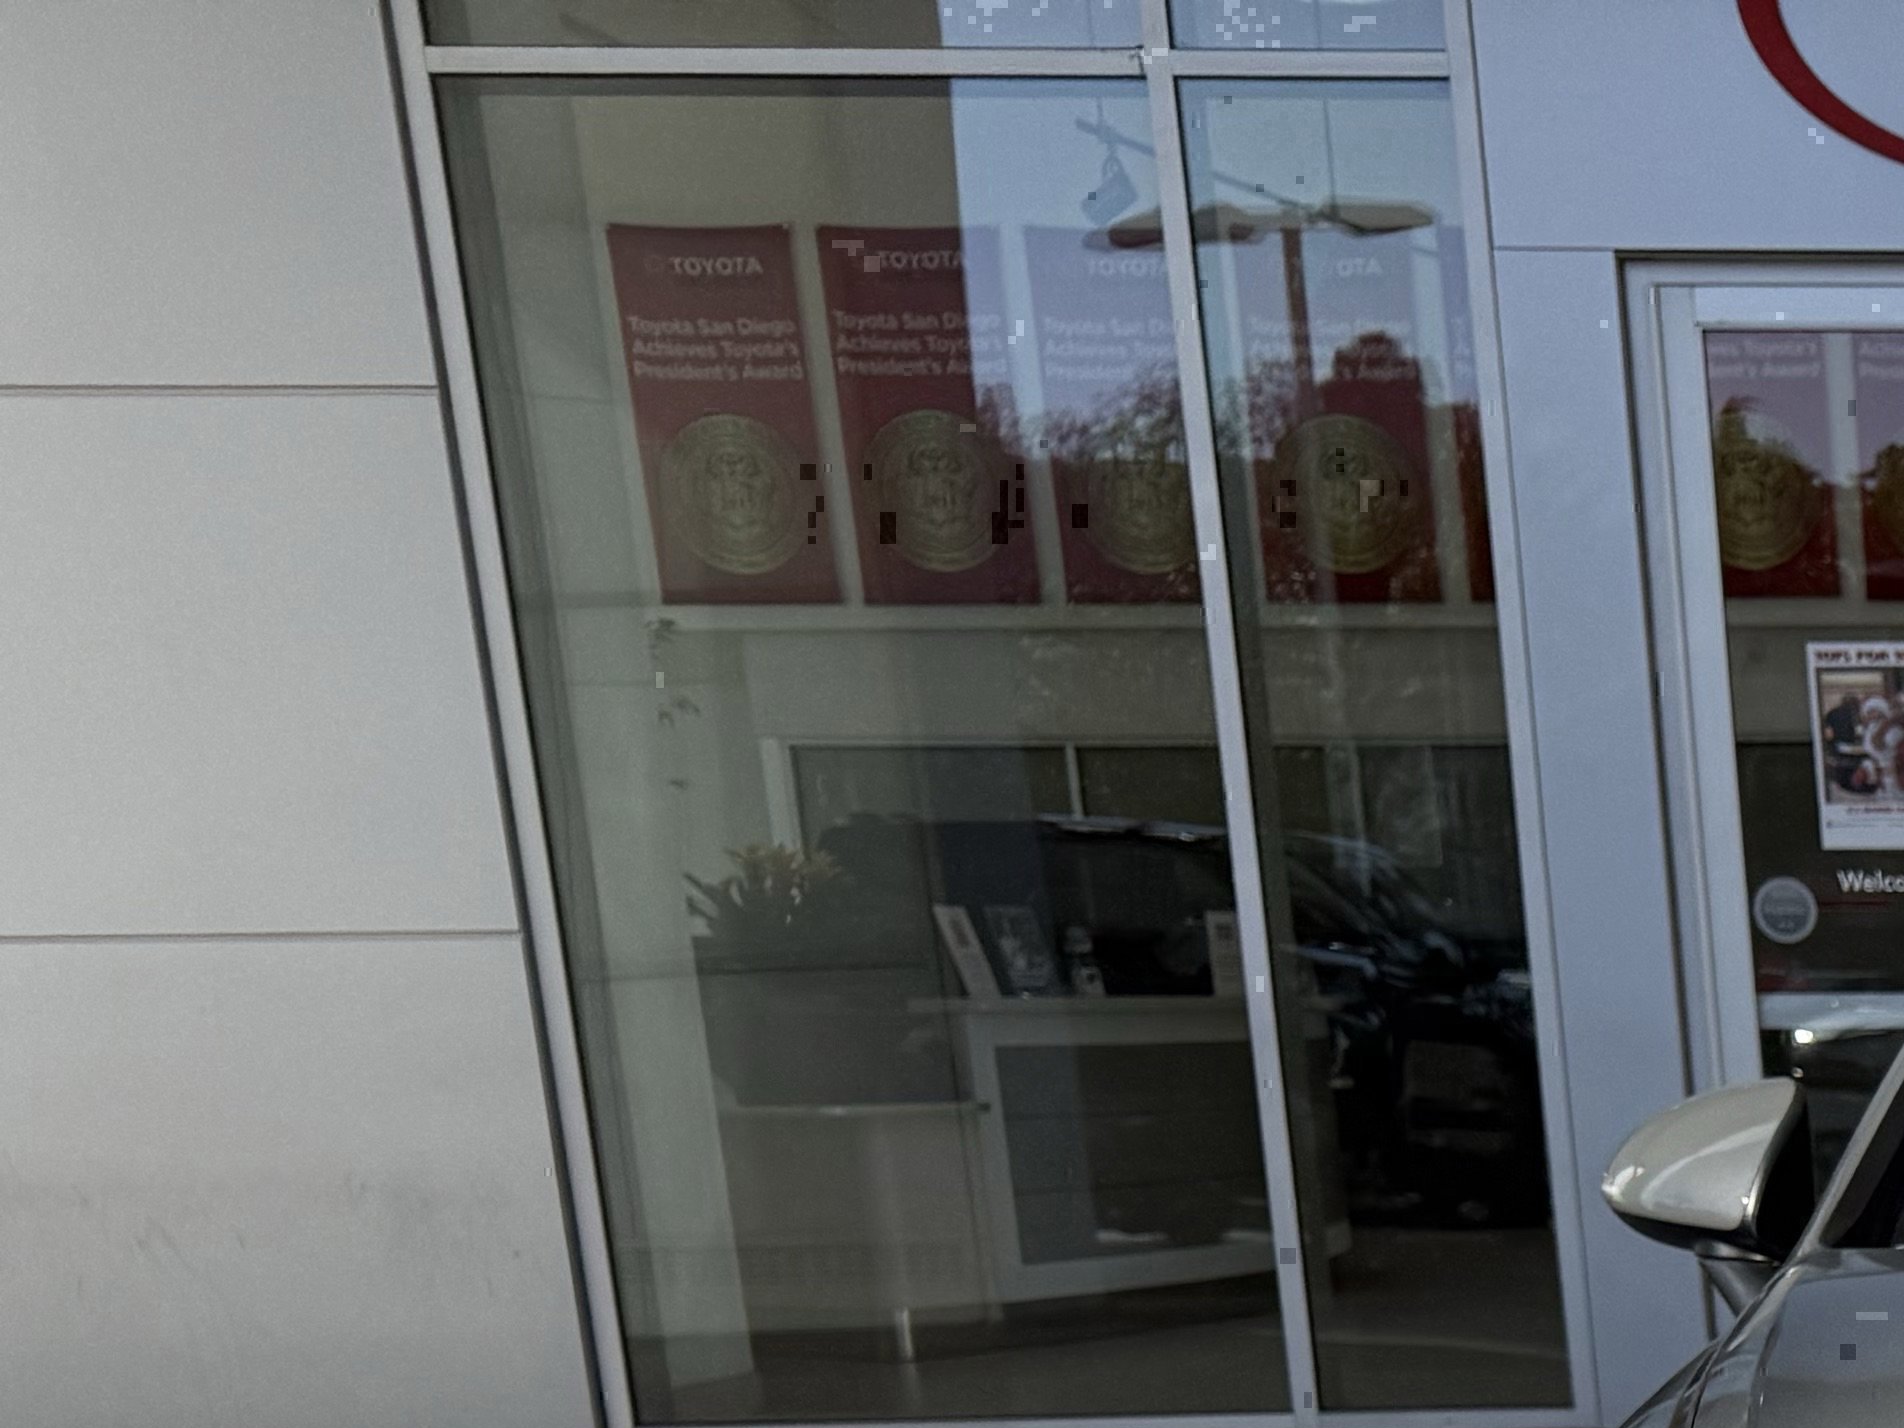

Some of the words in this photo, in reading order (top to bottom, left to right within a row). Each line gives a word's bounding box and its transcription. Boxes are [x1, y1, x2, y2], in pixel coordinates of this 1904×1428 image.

[668, 257, 764, 276] TOYOTA
[627, 315, 695, 337] Toyota
[697, 317, 735, 335] San
[832, 309, 898, 331] Toyota
